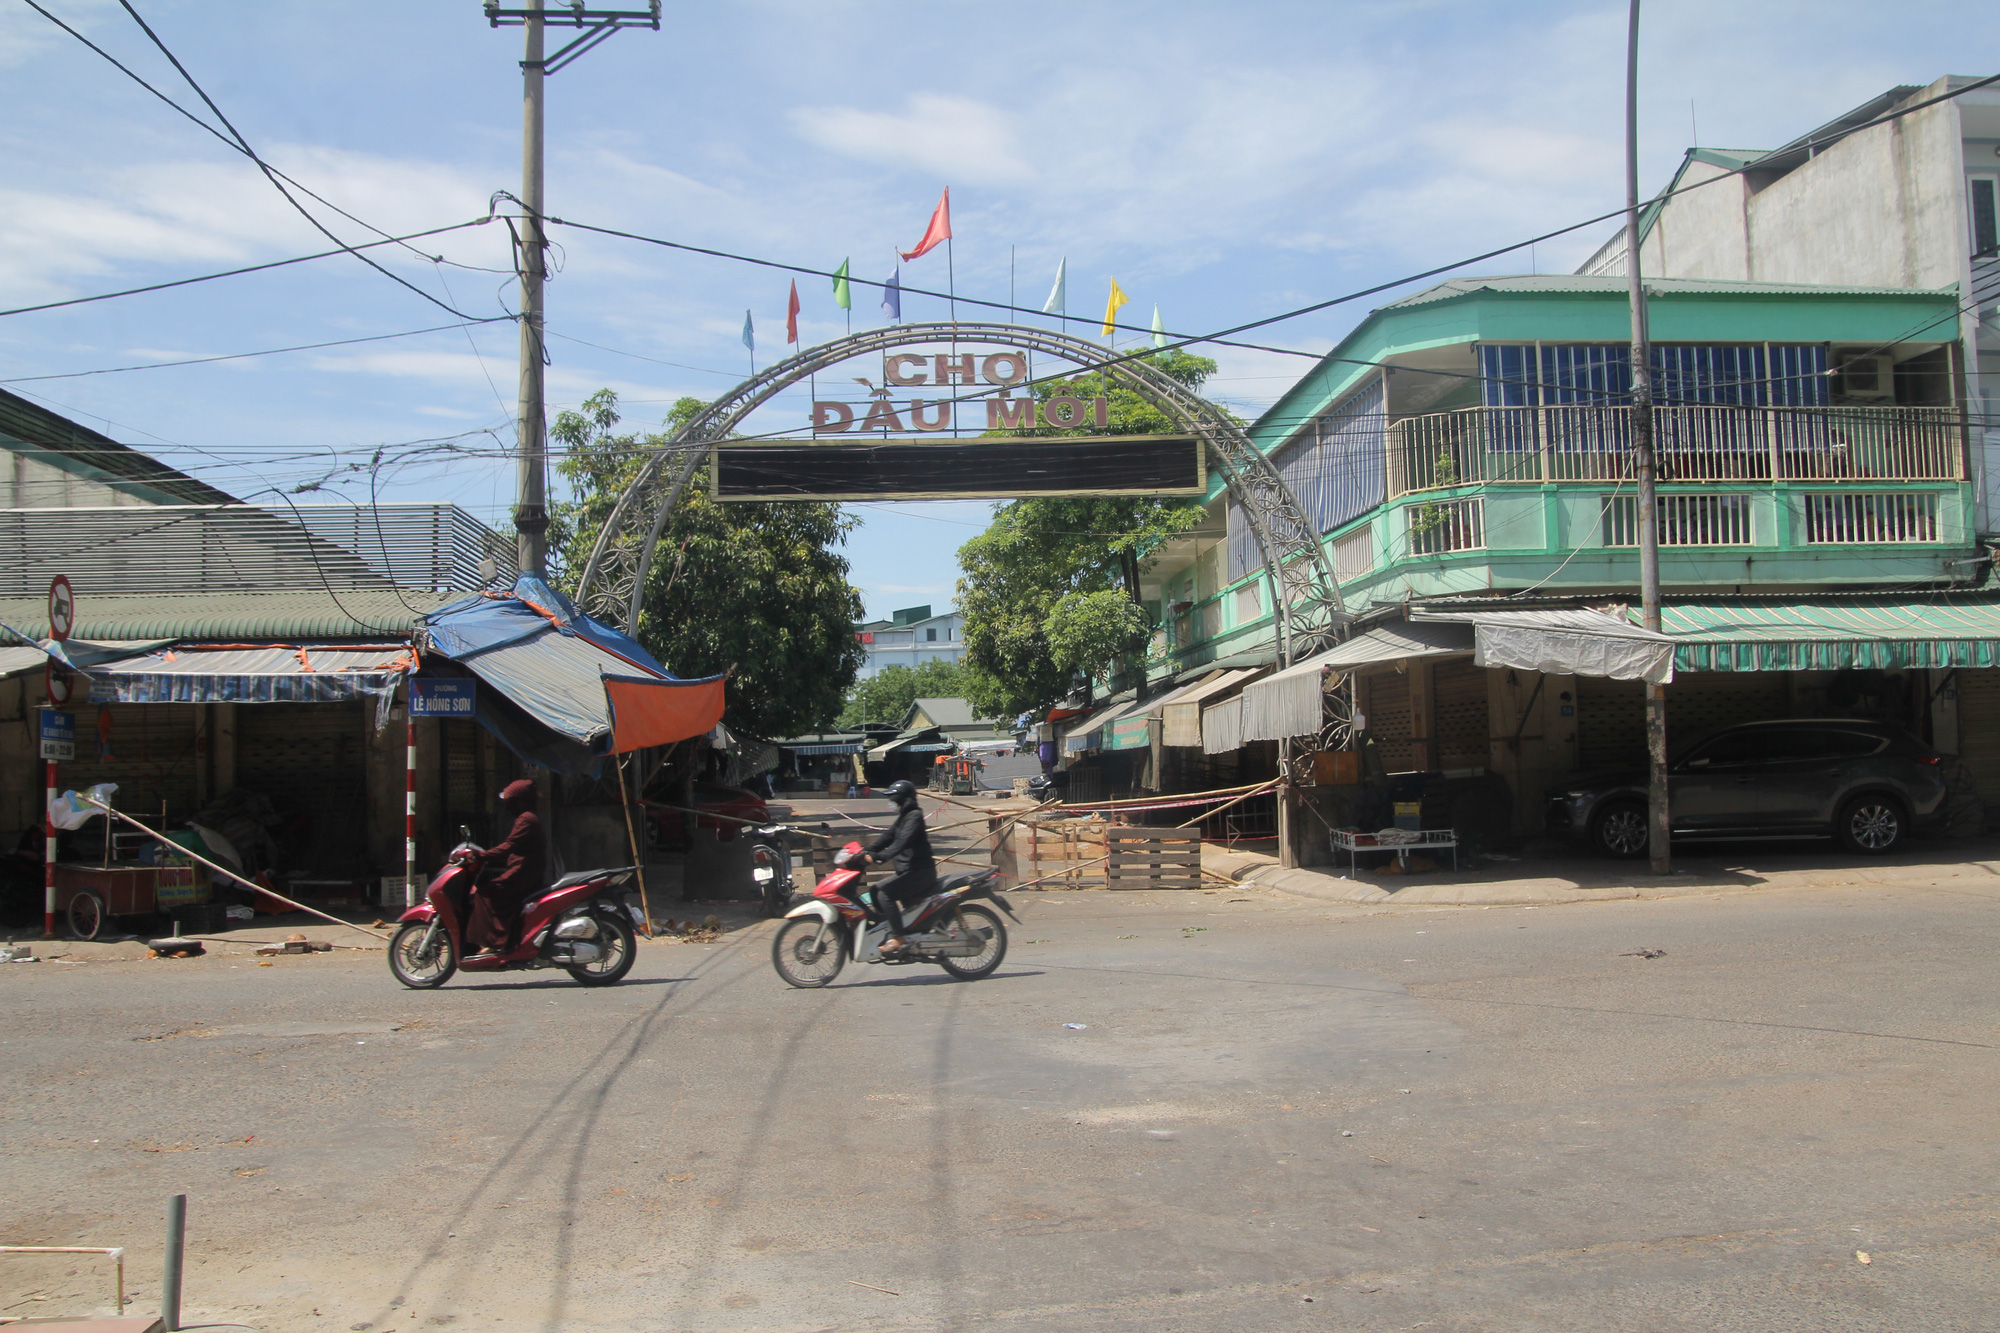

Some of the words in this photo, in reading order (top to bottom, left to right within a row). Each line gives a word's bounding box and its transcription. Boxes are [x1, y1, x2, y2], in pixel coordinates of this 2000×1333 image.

[885, 350, 1027, 397] CHỢ
[809, 377, 951, 432] ĐẦU
[986, 375, 1107, 429] MỐI
[414, 695, 424, 711] LÊ
[452, 697, 470, 711] SƠN
